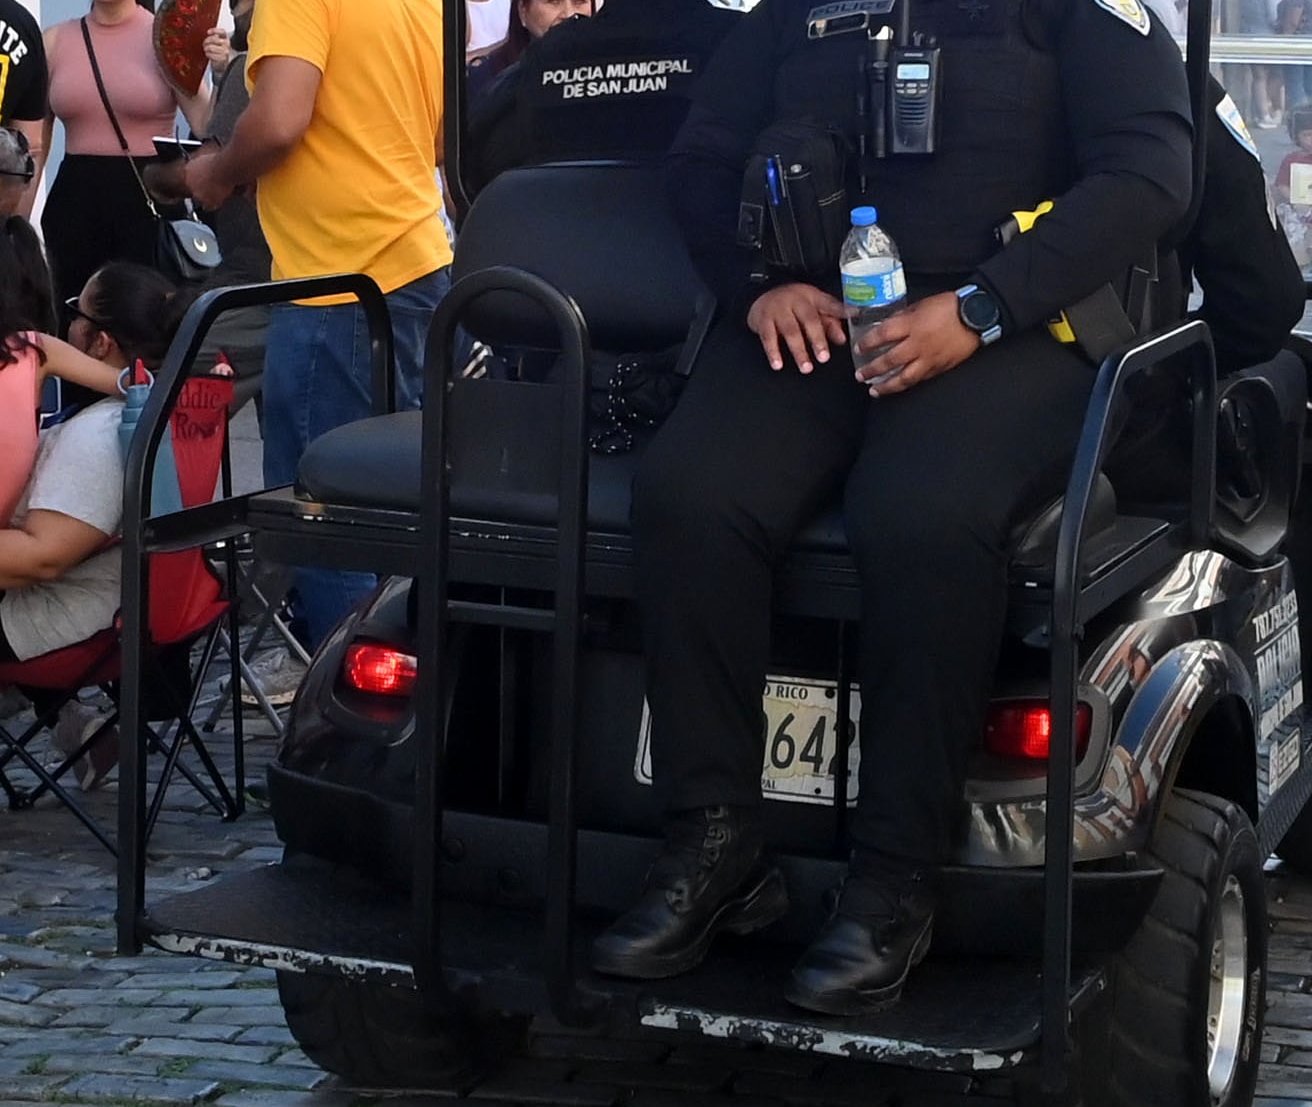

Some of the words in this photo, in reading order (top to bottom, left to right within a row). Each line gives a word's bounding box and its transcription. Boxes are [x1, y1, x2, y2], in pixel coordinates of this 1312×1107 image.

[542, 66, 604, 85] POLICIA
[606, 59, 693, 79] MUNICIPAL
[563, 83, 585, 99] DE
[587, 80, 621, 97] SAN
[623, 76, 668, 93] JUAN
[775, 684, 809, 701] RICO
